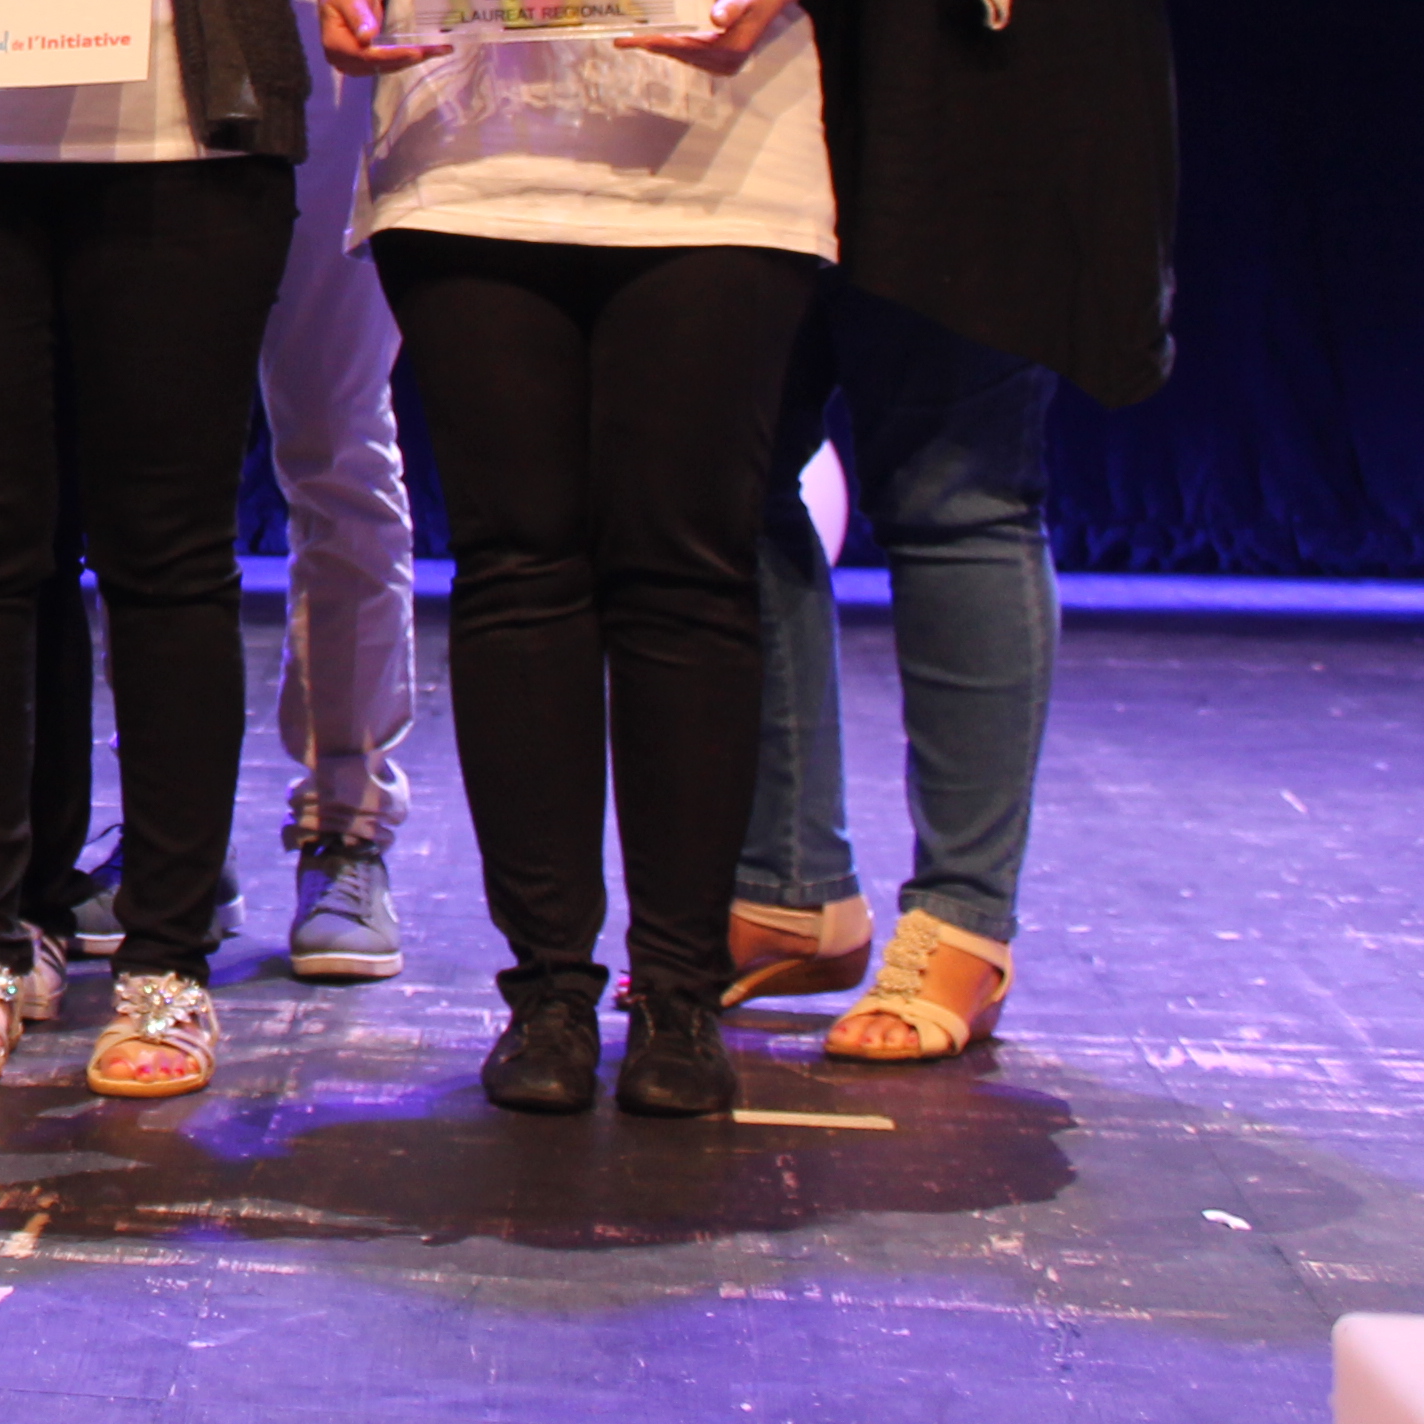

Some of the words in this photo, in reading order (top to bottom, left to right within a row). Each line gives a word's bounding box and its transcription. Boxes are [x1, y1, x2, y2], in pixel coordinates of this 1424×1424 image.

[459, 7, 536, 23] LAUREAT
[542, 3, 624, 20] REGIONAL
[27, 32, 132, 50] l'Initiative
